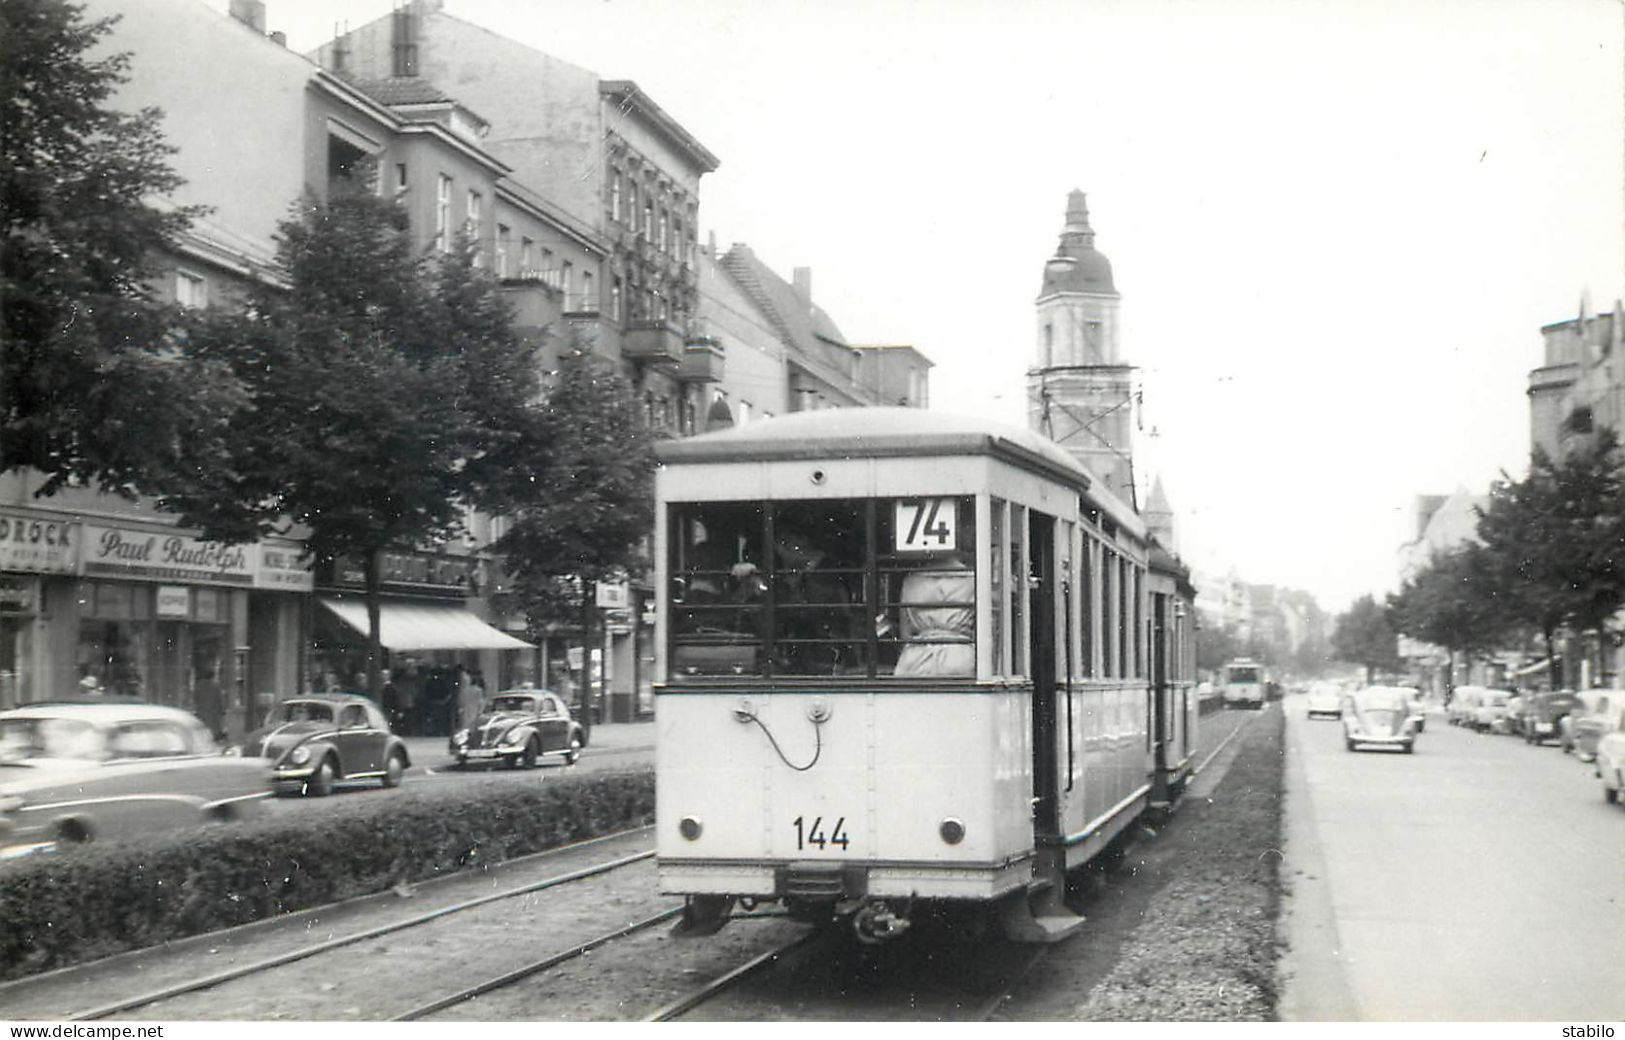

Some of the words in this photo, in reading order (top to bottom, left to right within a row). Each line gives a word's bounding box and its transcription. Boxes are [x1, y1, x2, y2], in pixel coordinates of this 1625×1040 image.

[97, 529, 155, 561] Paul
[161, 537, 245, 572] Rudolph
[793, 816, 850, 851] 144
